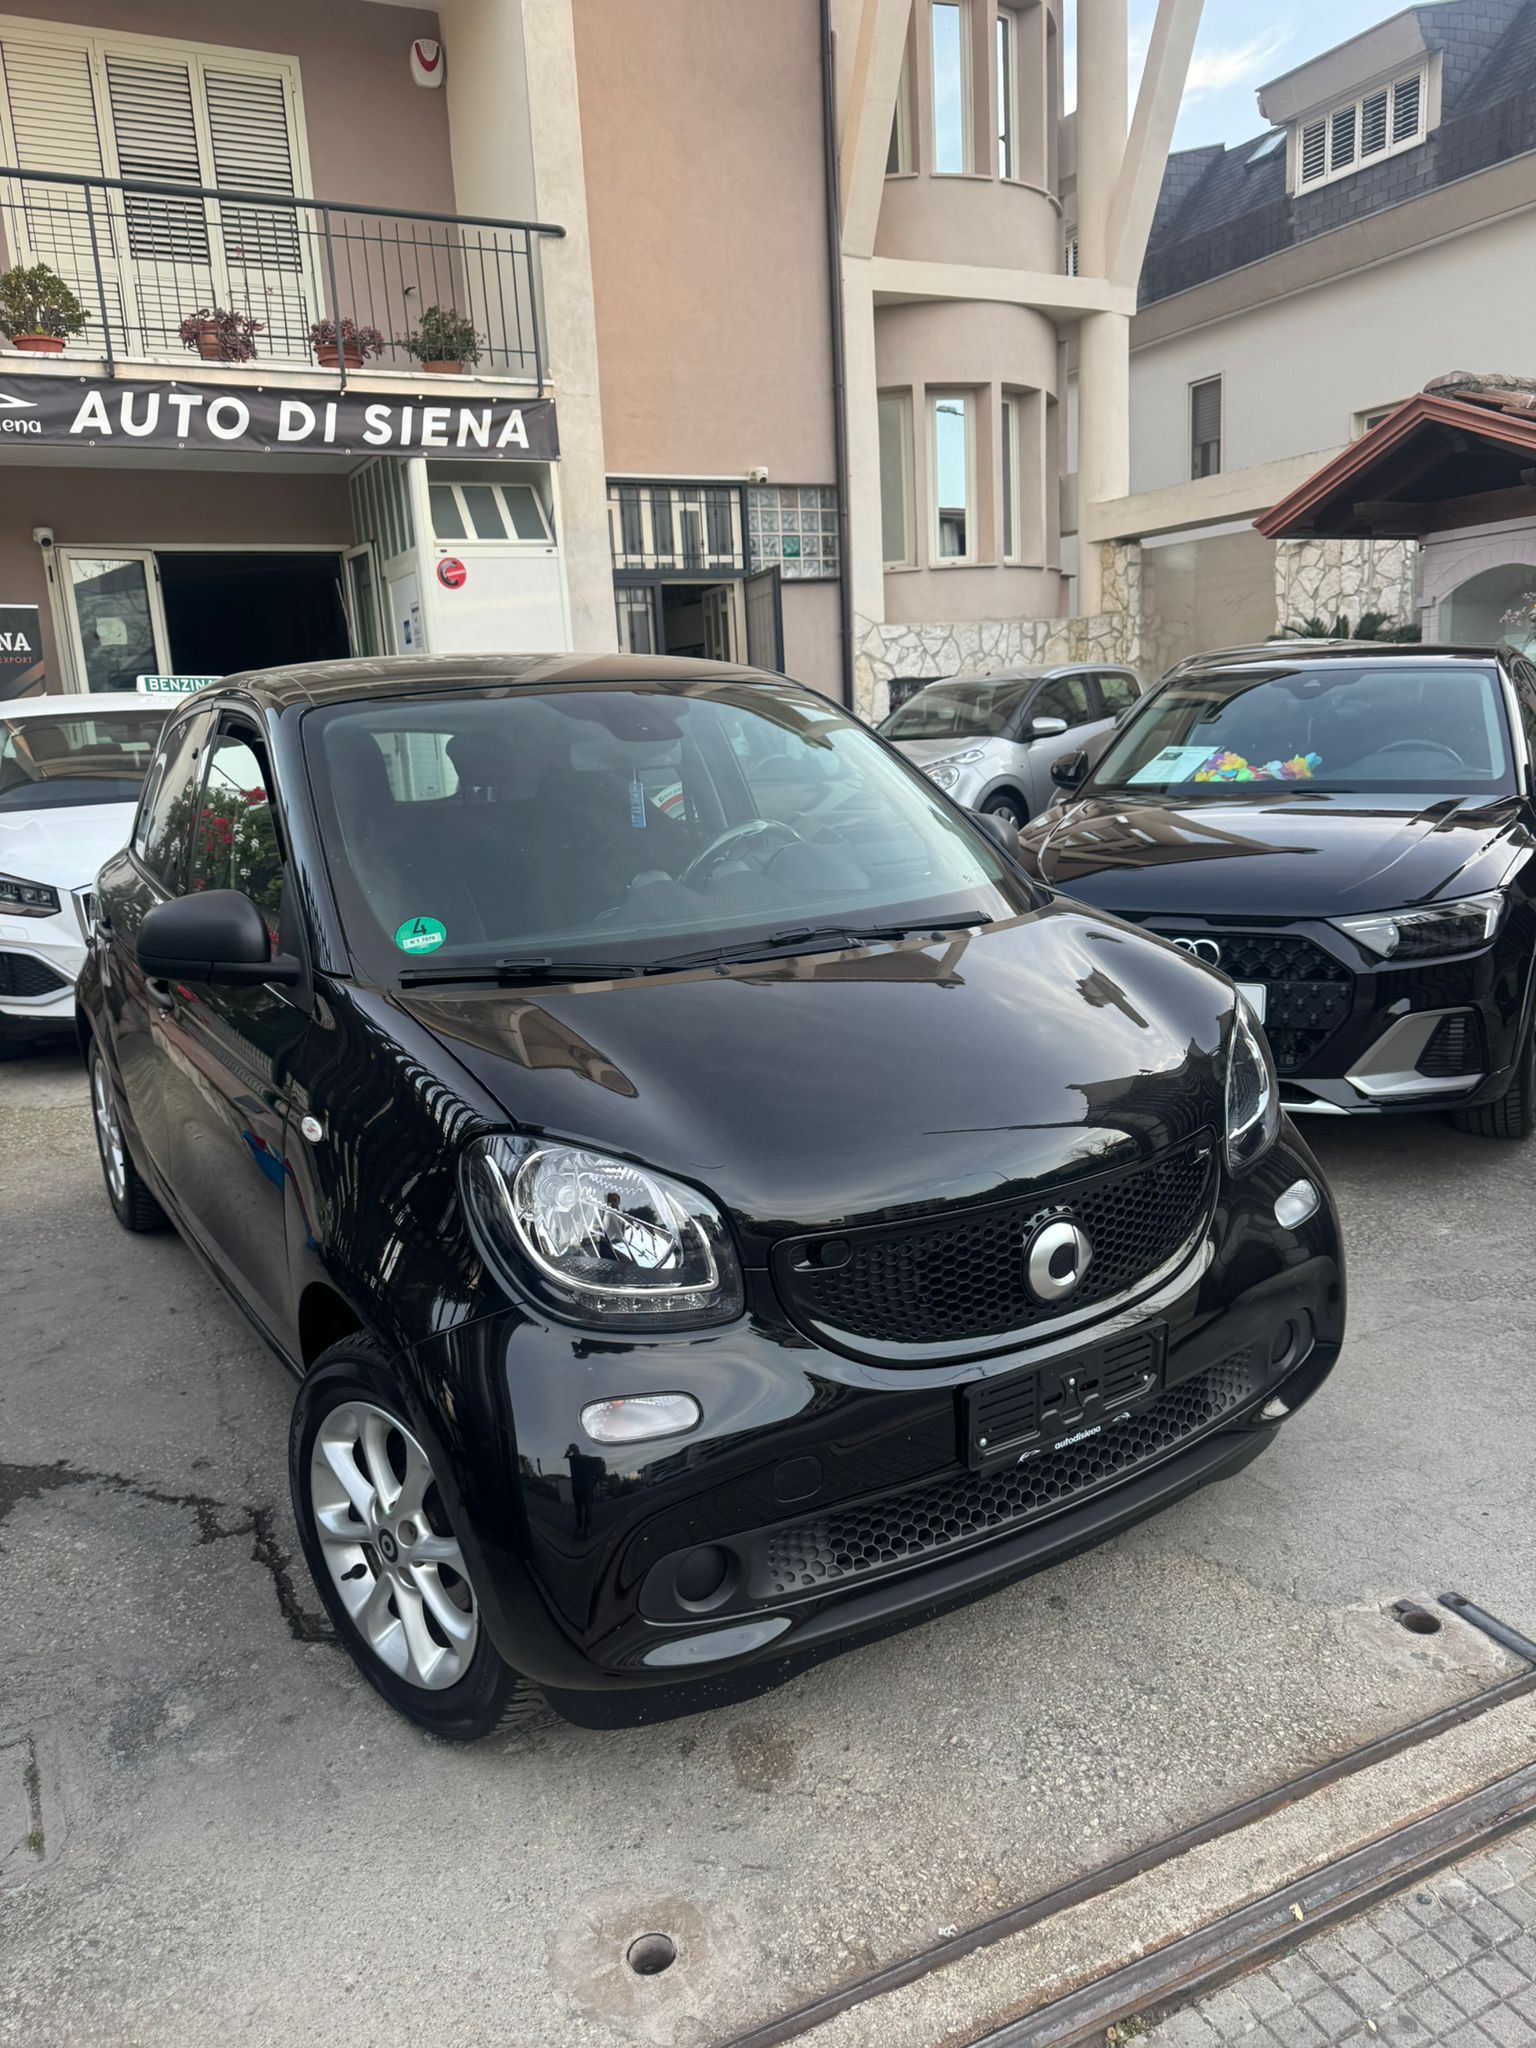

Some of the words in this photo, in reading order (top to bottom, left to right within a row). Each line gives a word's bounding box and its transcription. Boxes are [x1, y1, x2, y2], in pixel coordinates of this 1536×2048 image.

[0, 419, 42, 434] ena
[69, 390, 250, 440] AUTO
[277, 400, 337, 443] DI
[362, 404, 530, 449] SIENA
